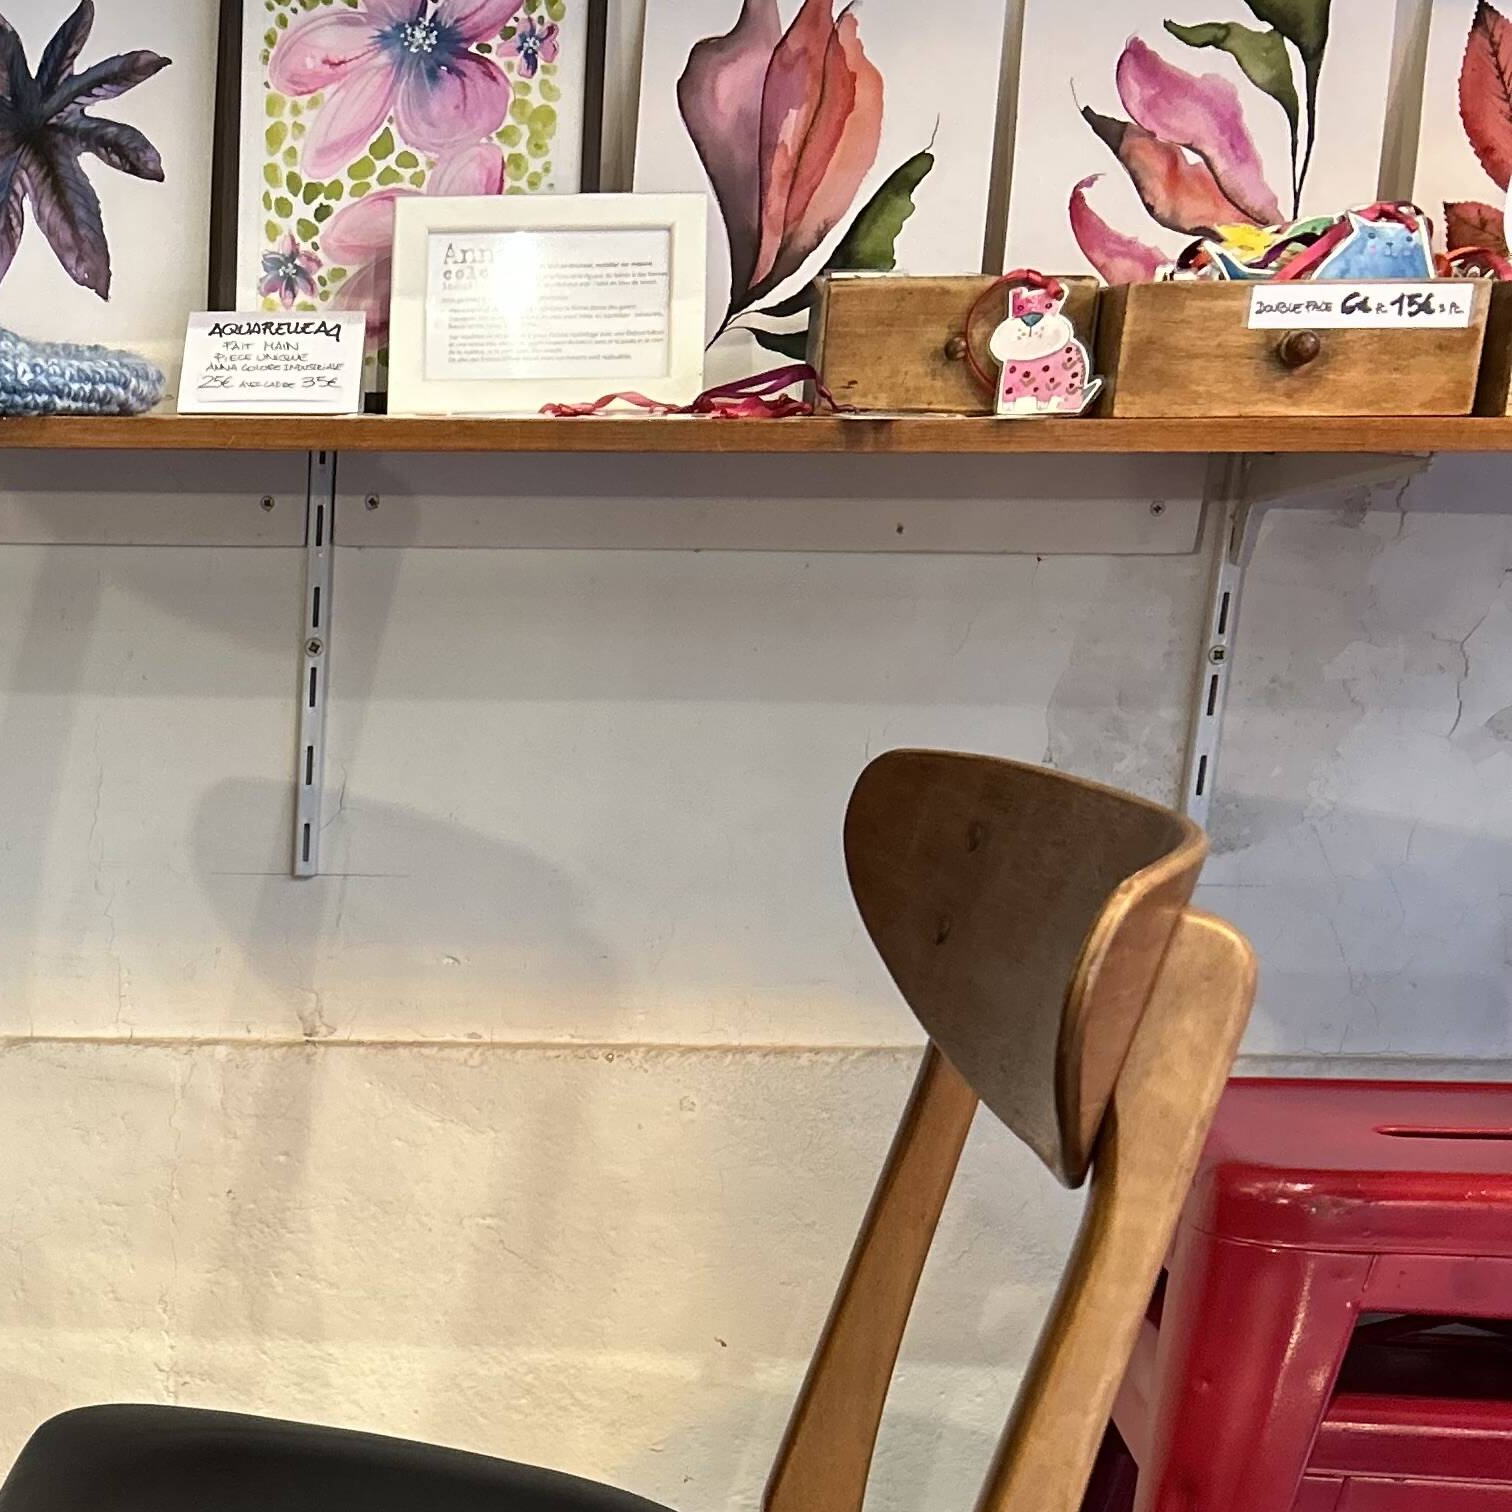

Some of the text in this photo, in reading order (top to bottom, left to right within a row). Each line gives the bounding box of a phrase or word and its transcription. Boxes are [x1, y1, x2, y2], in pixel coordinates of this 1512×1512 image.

[442, 242, 499, 265] Ann
[1255, 301, 1304, 314] DOUBLE
[222, 340, 300, 352] FAIT MAIN
[206, 362, 238, 372] ANNA
[197, 375, 234, 389] 25€
[301, 375, 343, 389] 35€
